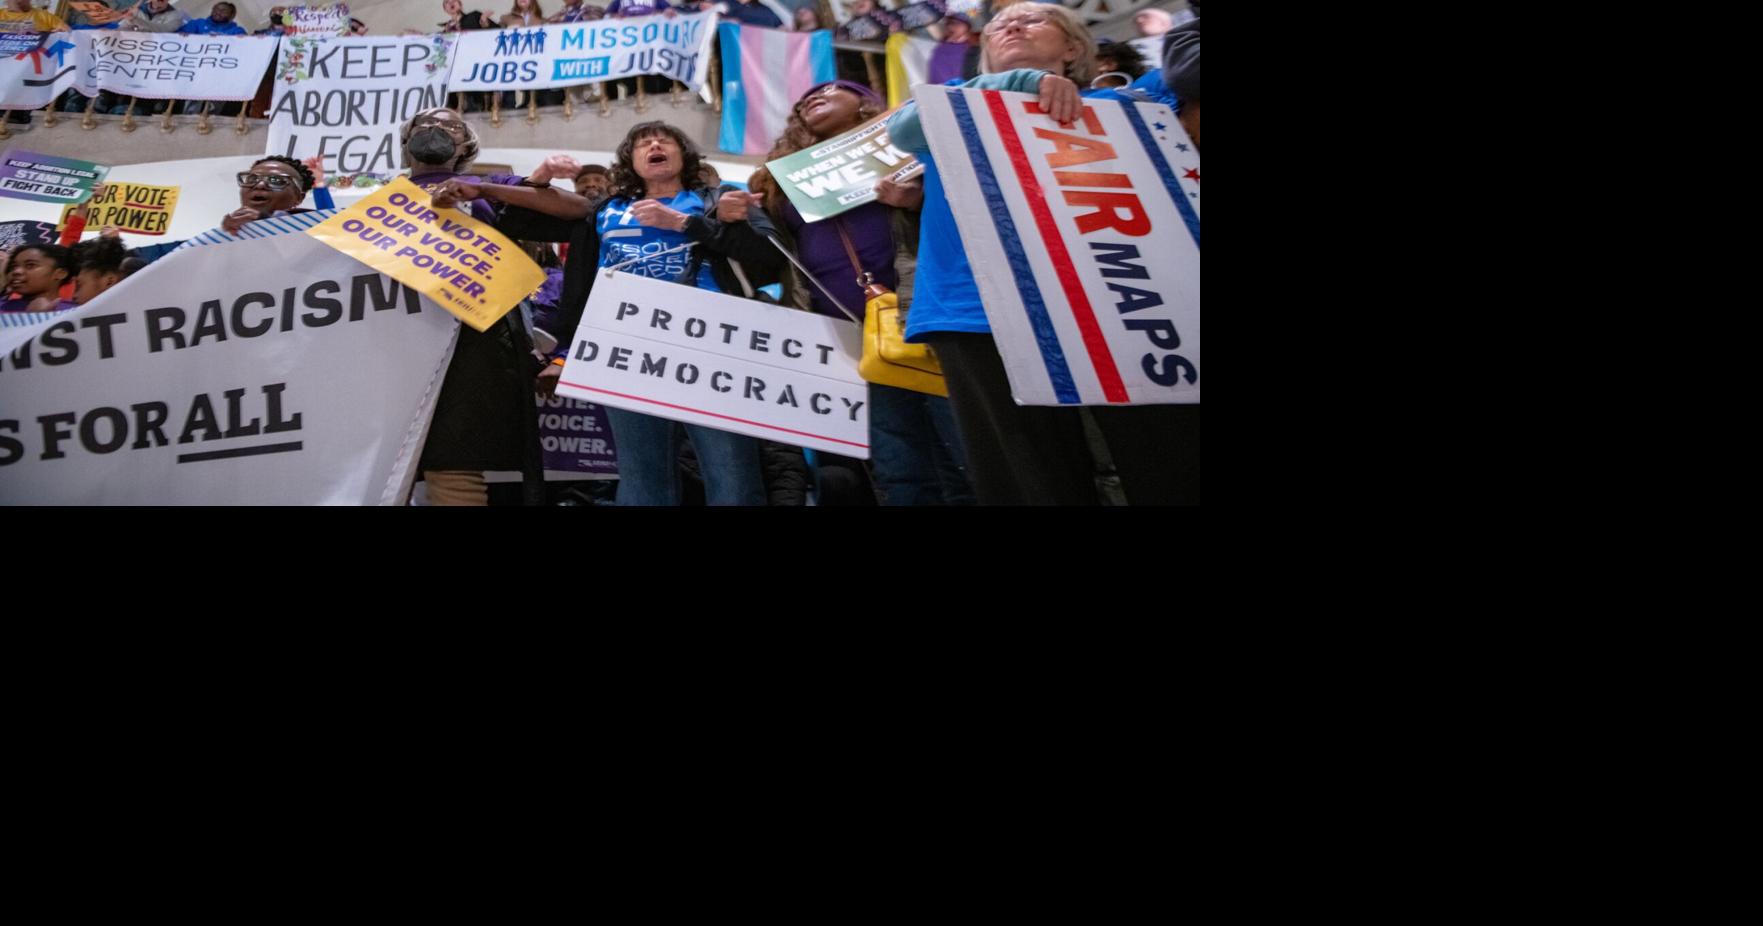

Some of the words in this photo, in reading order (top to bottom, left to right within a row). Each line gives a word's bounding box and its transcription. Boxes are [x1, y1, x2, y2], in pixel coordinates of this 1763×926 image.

[91, 36, 230, 55] MISSOURI
[308, 43, 430, 79] KEEP
[462, 61, 538, 83] JOBS
[559, 60, 603, 77] WITH
[269, 83, 447, 127] ABORTION
[286, 133, 396, 174] LEGA
[786, 155, 846, 183] WHEN
[846, 142, 878, 160] WE
[795, 160, 878, 199] WE
[872, 143, 912, 167] W
[4, 180, 42, 192] FIGHT
[43, 186, 78, 196] BACK
[15, 169, 61, 184] STAND
[62, 176, 80, 186] UP
[92, 185, 118, 205] UR
[124, 185, 170, 206] VOTE
[104, 207, 168, 231] POWER
[388, 193, 439, 225] OUR
[440, 219, 502, 261] VOTE.
[342, 219, 398, 250] OUR
[395, 246, 486, 304] POWER.
[366, 206, 419, 237] OUR
[419, 232, 493, 280] VOICE.
[1021, 101, 1153, 237] FAIR
[1088, 241, 1198, 388] MAPS
[144, 272, 423, 354] RACISM
[615, 301, 834, 365] PROTECT
[574, 340, 865, 422] DEMOCRACY
[37, 400, 170, 461] FOR
[177, 382, 303, 444] ALL
[541, 435, 613, 455] OWER.
